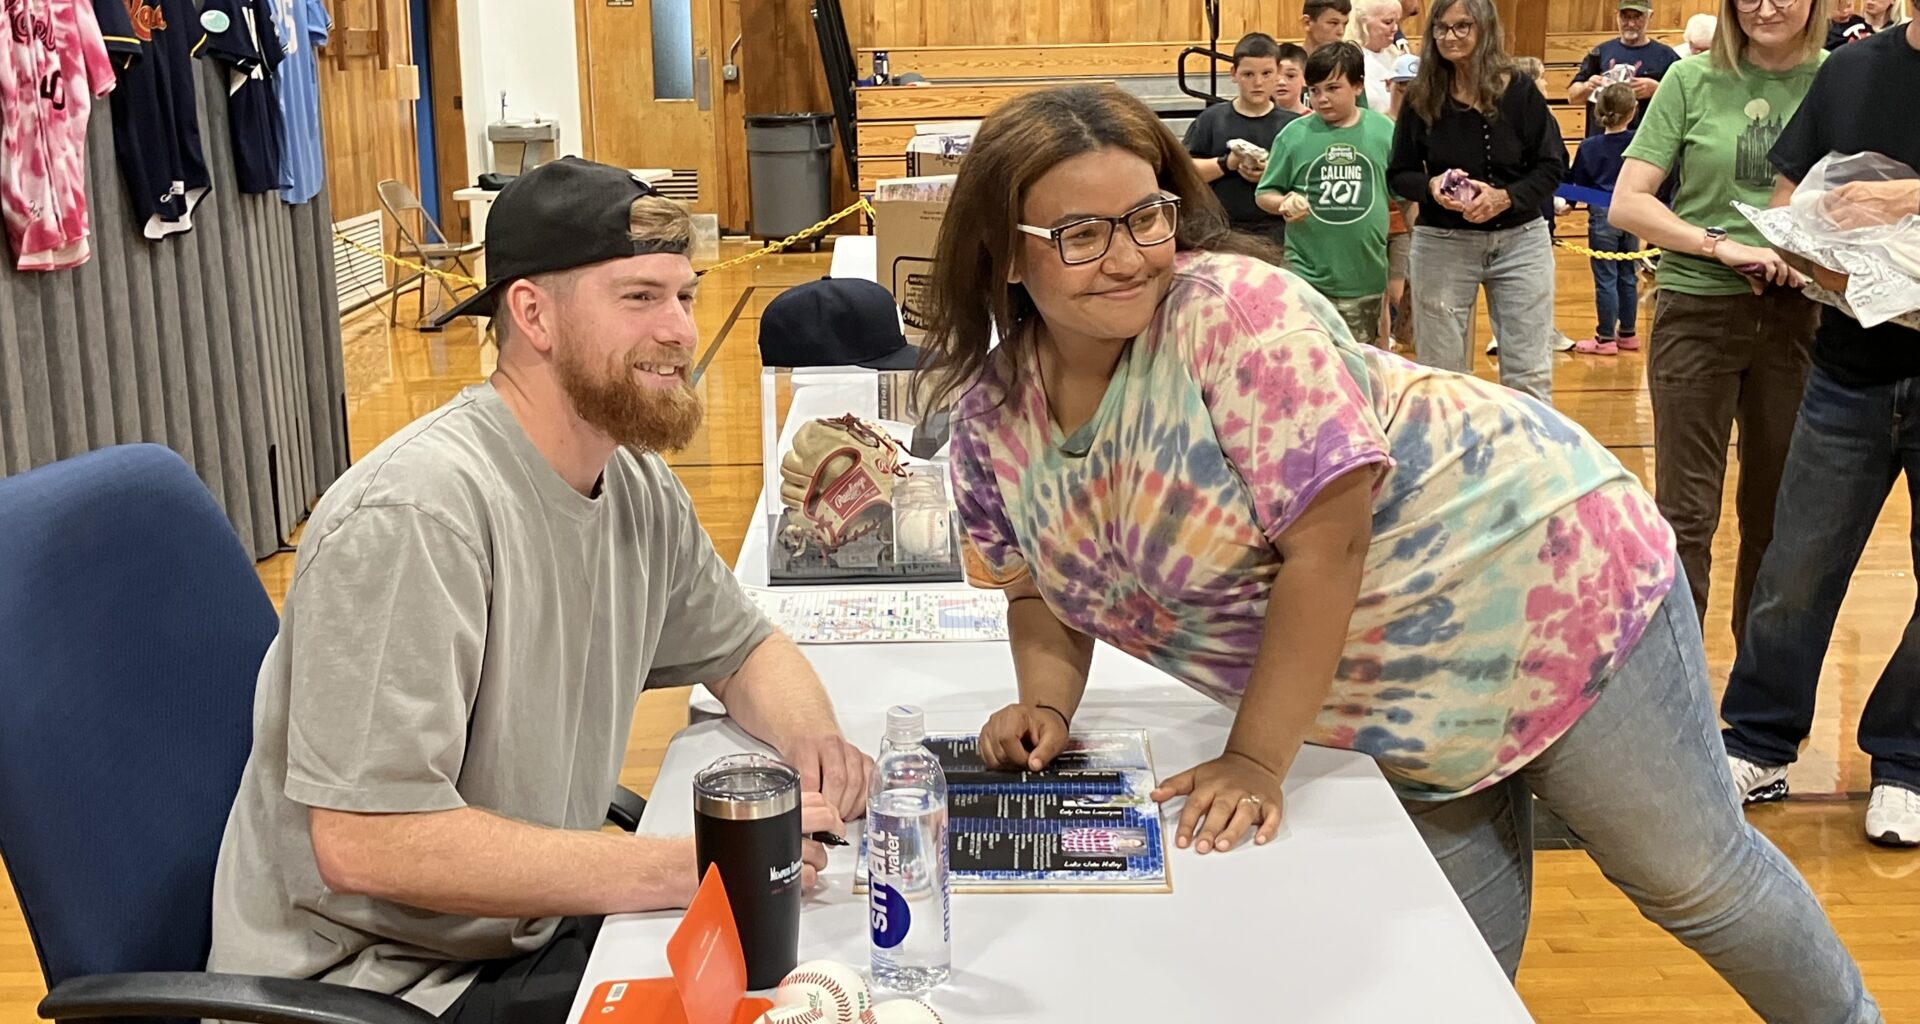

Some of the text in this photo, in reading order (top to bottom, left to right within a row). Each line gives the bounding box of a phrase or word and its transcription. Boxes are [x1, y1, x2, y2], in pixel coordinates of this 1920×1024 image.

[1320, 165, 1362, 180] CALLING
[1318, 180, 1361, 205] 207
[886, 831, 900, 877] water
[868, 830, 888, 933] smart
